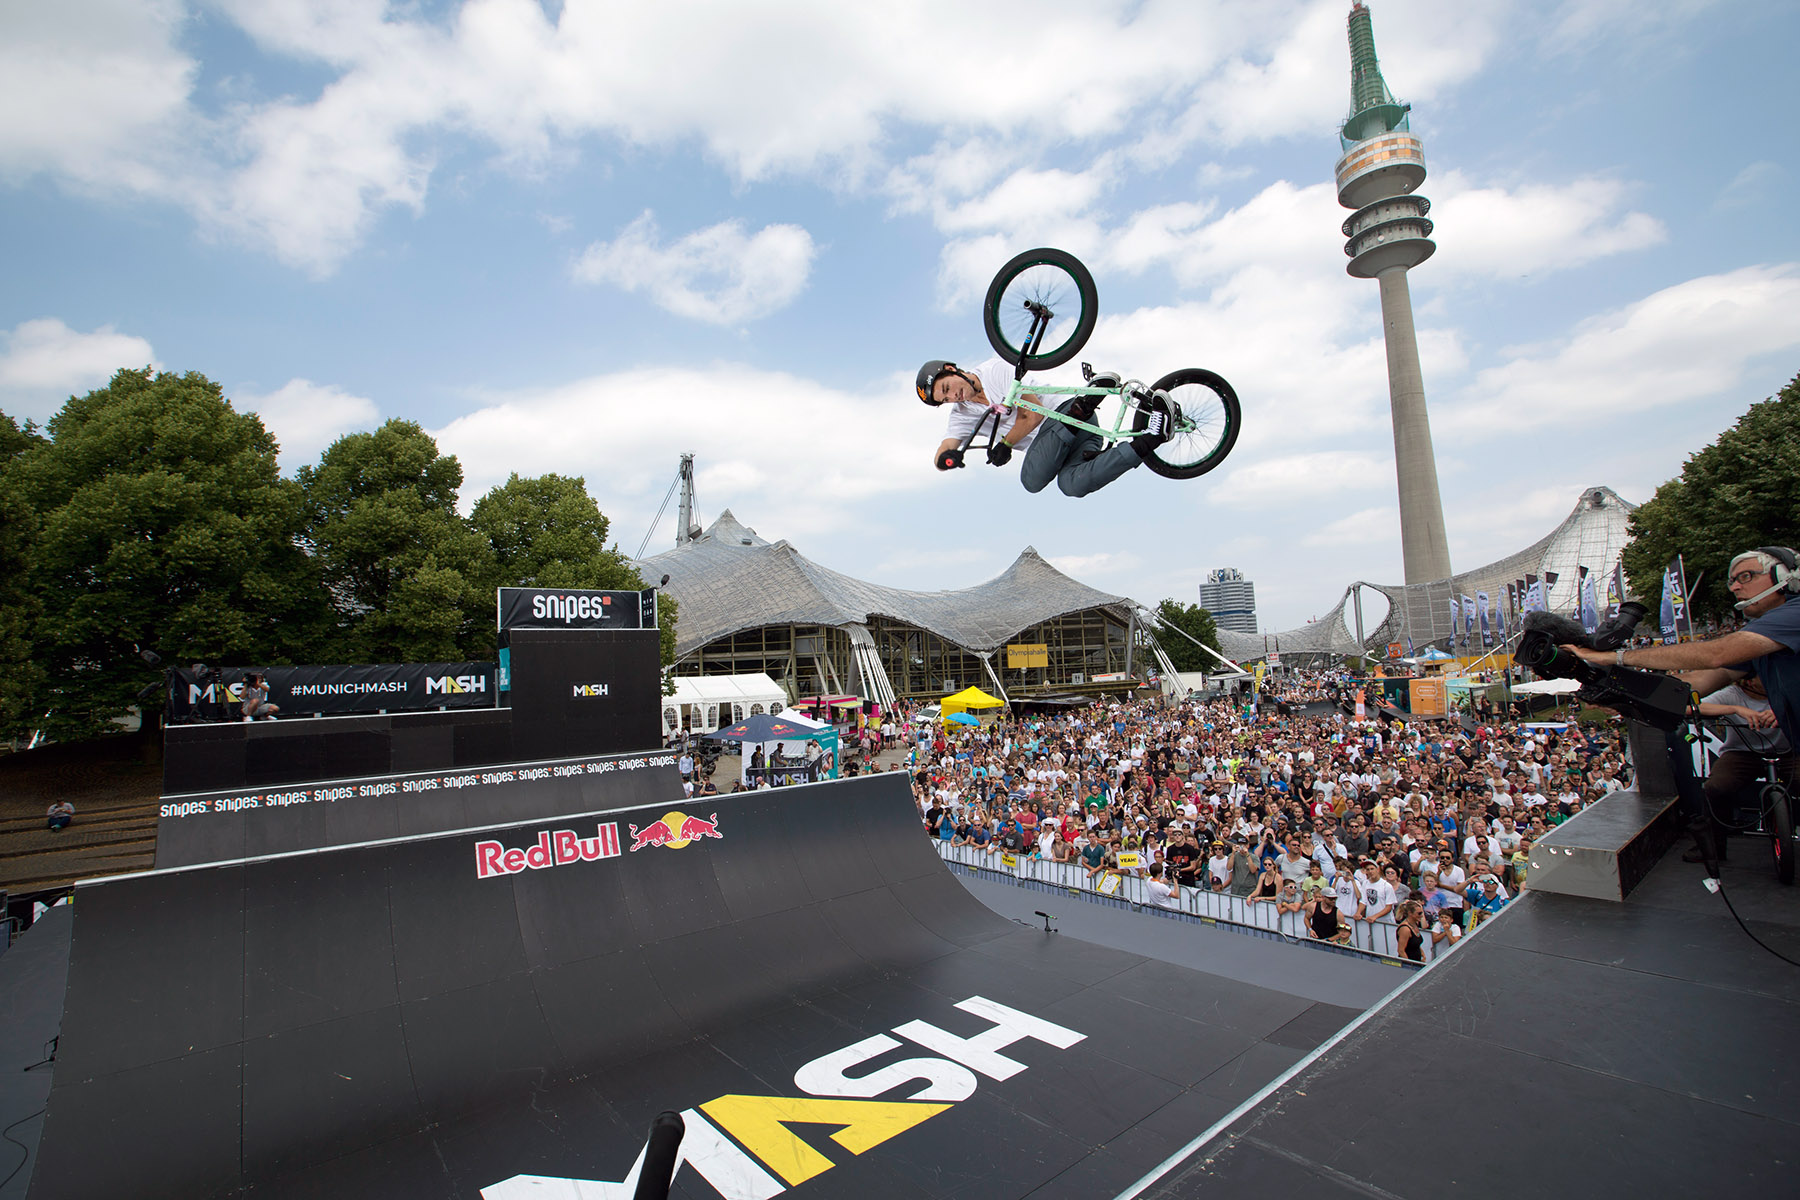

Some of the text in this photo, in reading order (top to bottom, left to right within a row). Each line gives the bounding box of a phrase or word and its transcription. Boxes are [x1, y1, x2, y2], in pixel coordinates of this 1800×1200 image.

[532, 594, 603, 624] snipes
[290, 681, 408, 696] #MUNICHMASH
[425, 674, 486, 695] MASH
[573, 683, 609, 697] MASH
[161, 755, 676, 818] snipes snipes snipes snipes snipes snipes snipes snipes snipes snipes snipes snipes snipes
[774, 772, 809, 787] MASH
[474, 821, 622, 879] Red Bull
